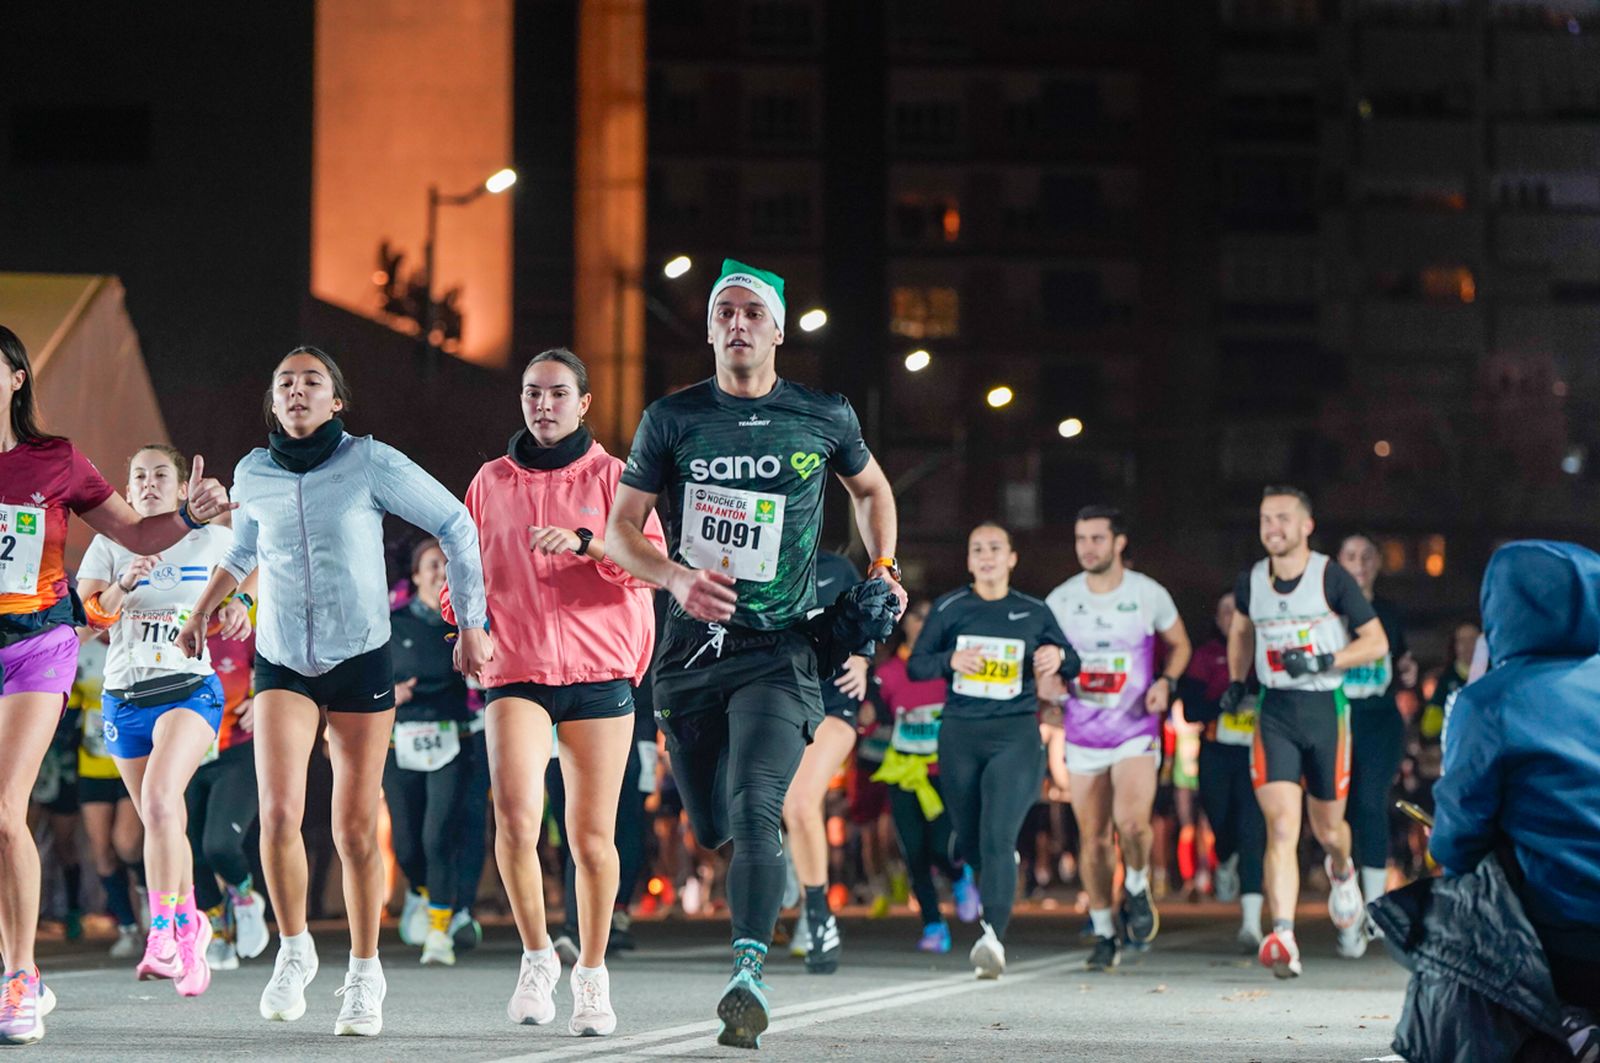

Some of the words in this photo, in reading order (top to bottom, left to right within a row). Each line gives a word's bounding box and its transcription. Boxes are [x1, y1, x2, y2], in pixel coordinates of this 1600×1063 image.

[726, 276, 752, 284] sano
[689, 455, 780, 481] sano
[707, 494, 734, 508] NOCHE
[735, 500, 748, 510] DE
[695, 502, 713, 514] SAN
[714, 507, 747, 521] ANTÓN
[701, 515, 762, 550] 6091
[413, 735, 443, 752] 654
